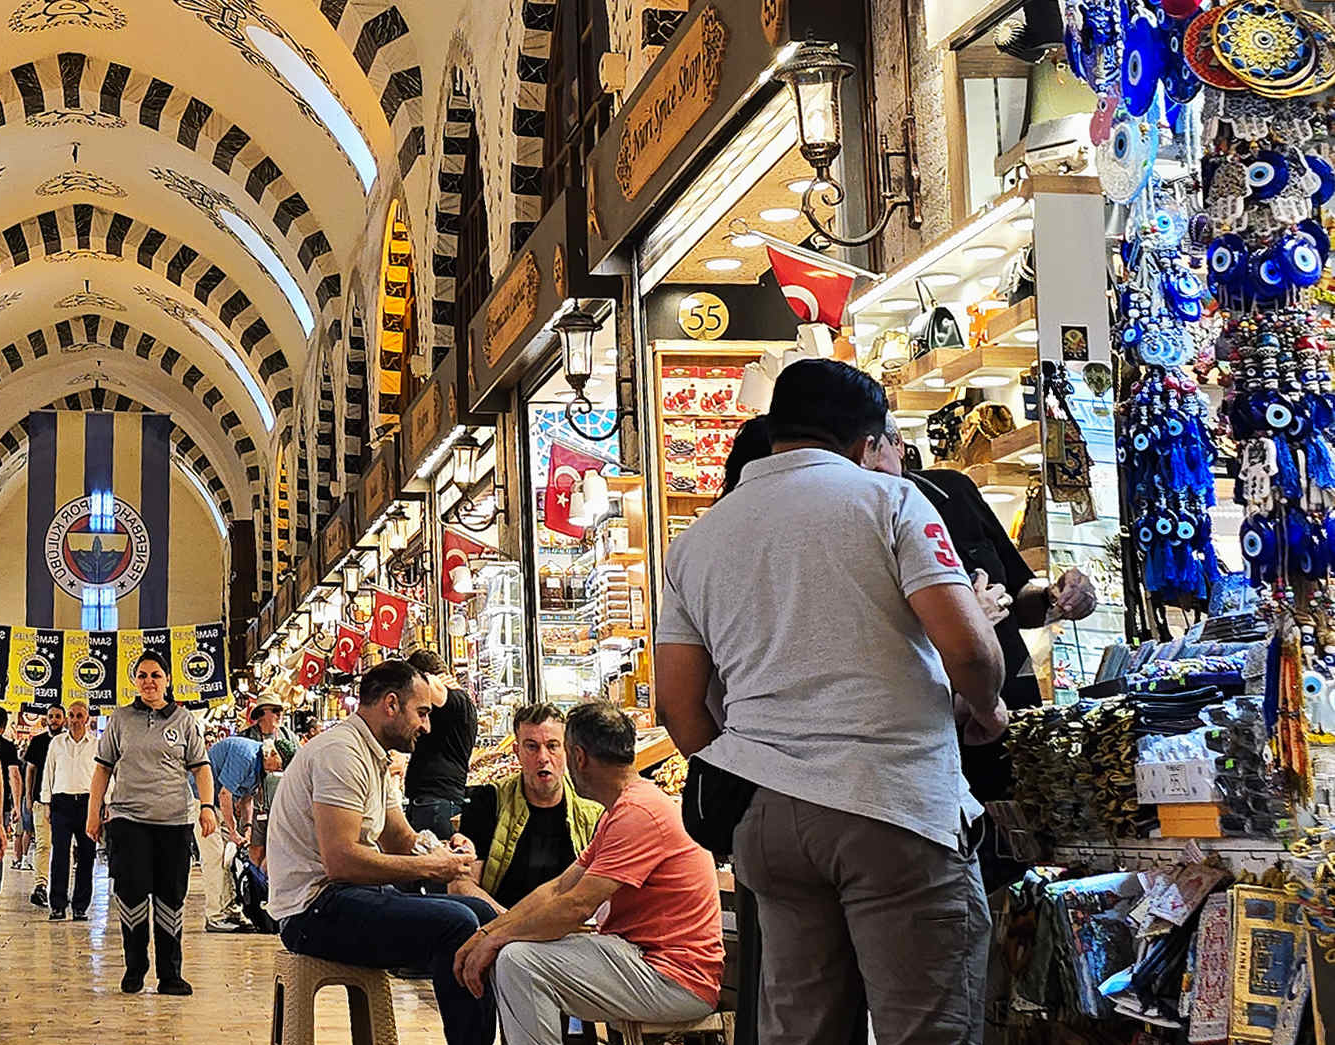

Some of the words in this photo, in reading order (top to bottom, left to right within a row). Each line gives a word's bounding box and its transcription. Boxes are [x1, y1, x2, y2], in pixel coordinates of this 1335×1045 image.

[654, 83, 677, 143] Spice
[678, 52, 702, 101] Shop
[687, 304, 721, 331] 55
[924, 523, 960, 567] 3
